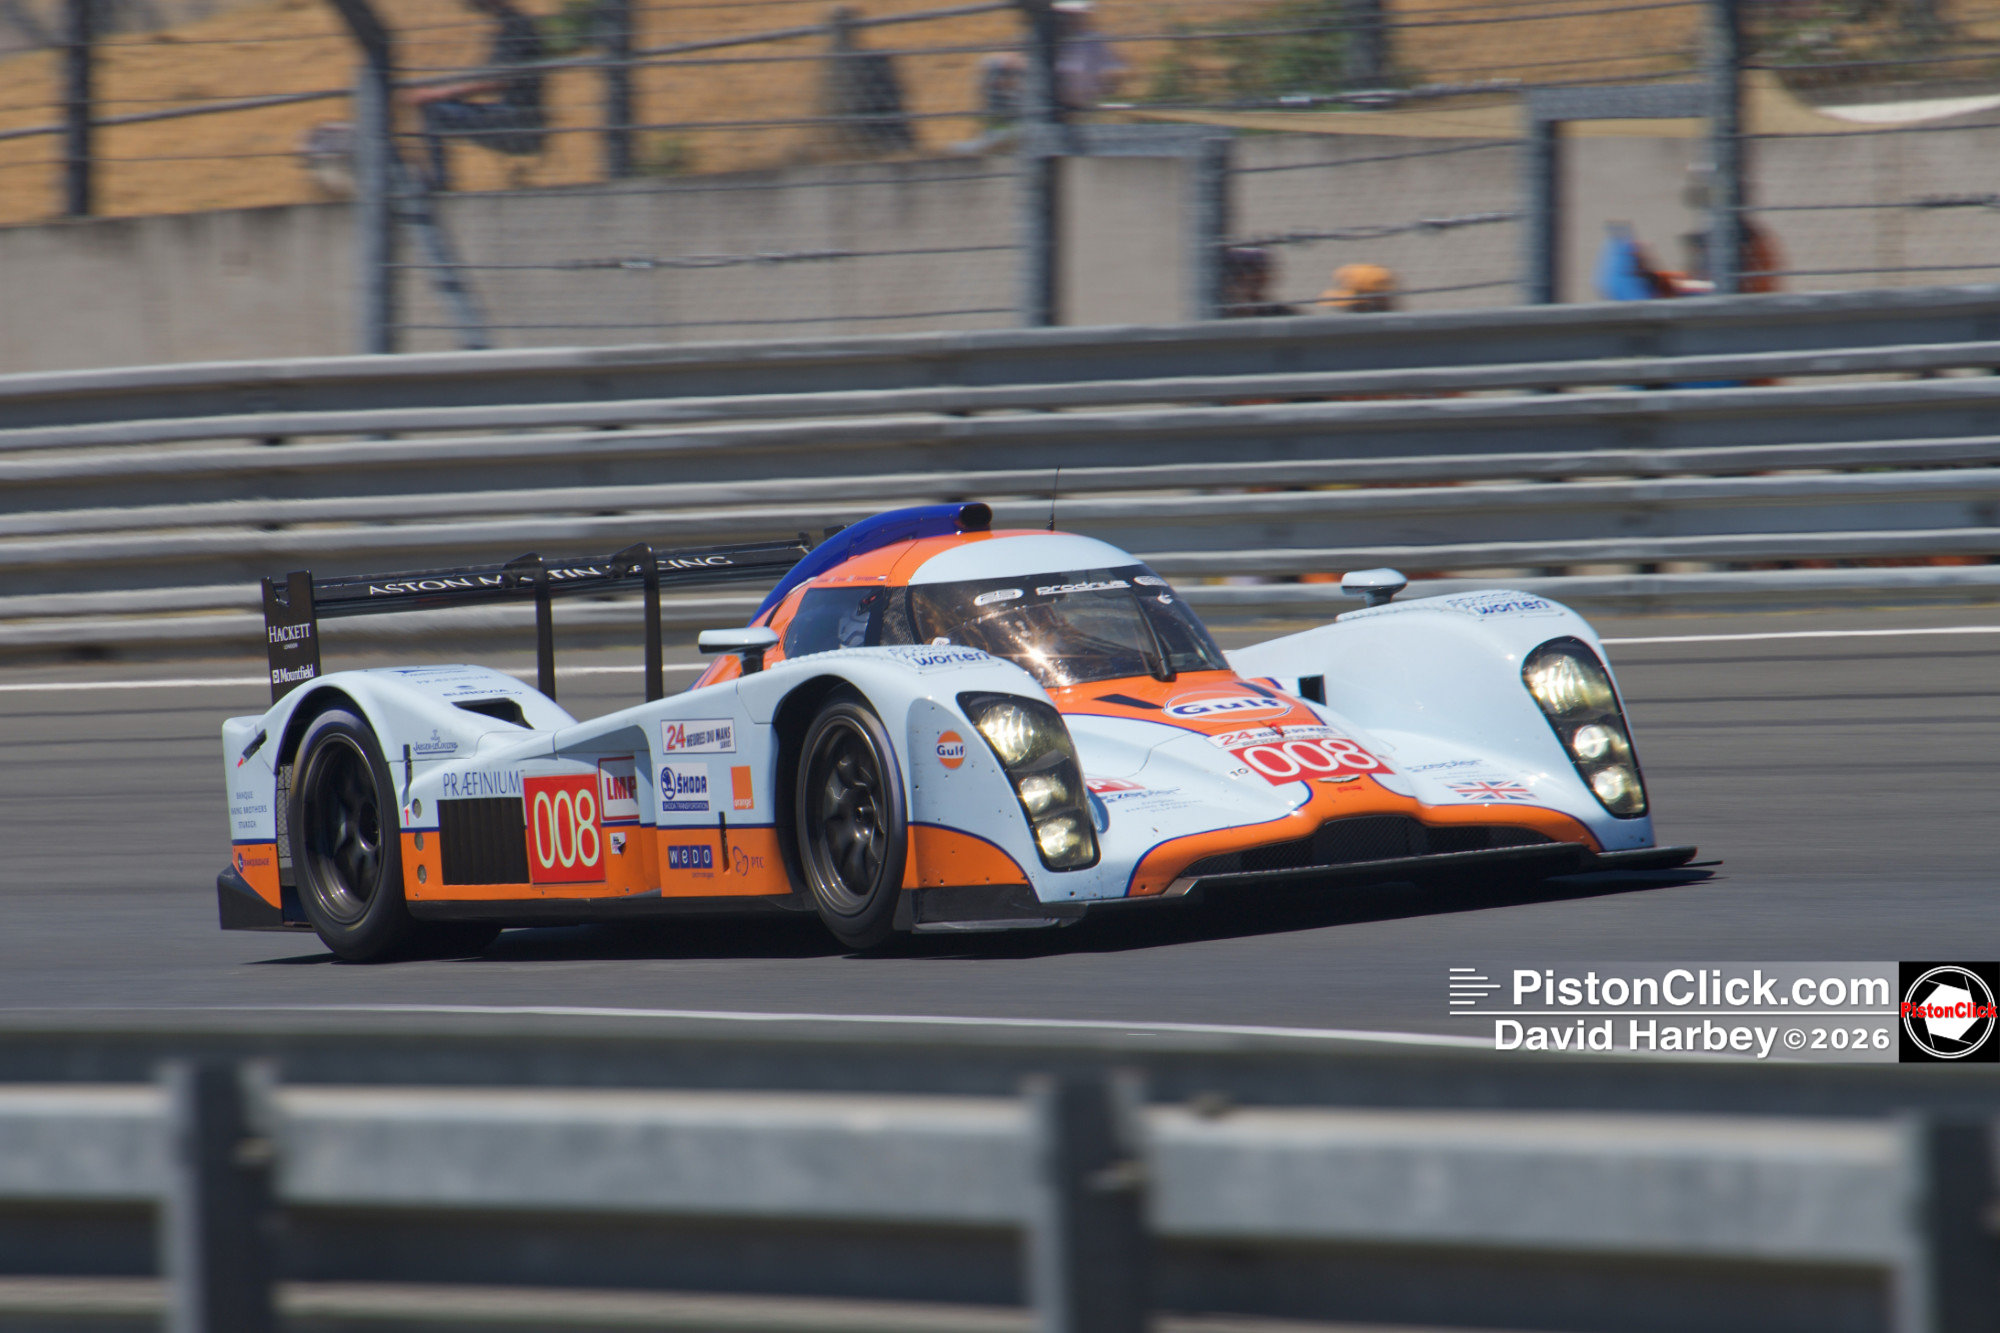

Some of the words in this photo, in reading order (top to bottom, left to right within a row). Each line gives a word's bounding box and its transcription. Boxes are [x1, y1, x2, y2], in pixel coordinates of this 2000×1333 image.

[369, 577, 473, 595] ASTON
[268, 622, 311, 643] HACKETT
[913, 652, 990, 666] worten
[280, 664, 315, 683] Mountfield
[1172, 699, 1279, 715] Gulf
[666, 723, 687, 751] 24
[686, 731, 706, 748] HEURES
[706, 730, 715, 743] DU
[715, 726, 731, 741] MANS
[1220, 731, 1254, 746] 24
[936, 744, 964, 756] Gulf
[1243, 739, 1379, 777] 008
[677, 772, 707, 794] ŠKODA
[533, 789, 600, 869] 008
